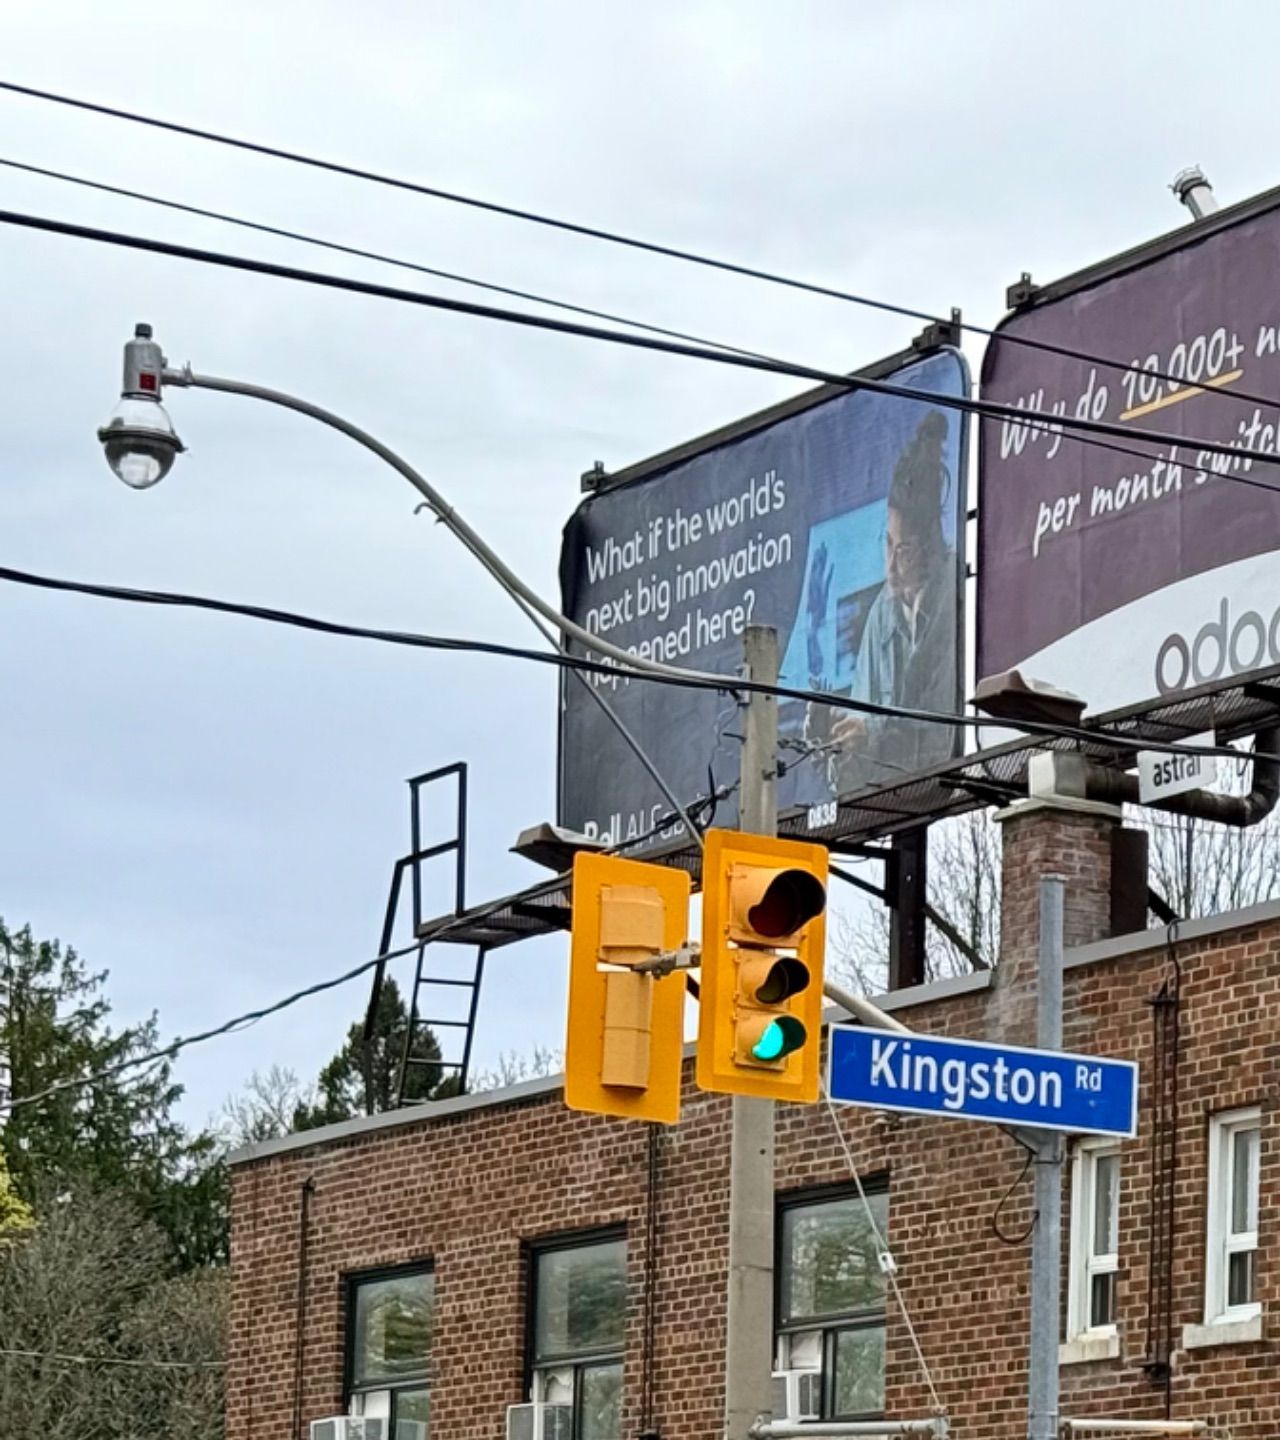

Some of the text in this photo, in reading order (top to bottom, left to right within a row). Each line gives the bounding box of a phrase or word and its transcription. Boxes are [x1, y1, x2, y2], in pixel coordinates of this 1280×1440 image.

[1001, 389, 1066, 459] Why
[1075, 368, 1107, 422] do
[1122, 328, 1245, 411] 10,000+
[586, 470, 785, 584] What if the world's
[1033, 492, 1081, 558] per
[1091, 445, 1182, 517] month
[586, 532, 791, 635] next big innovation
[697, 589, 755, 649] here?
[1153, 753, 1200, 787] astral
[870, 1039, 1102, 1109] Kingston Rd
